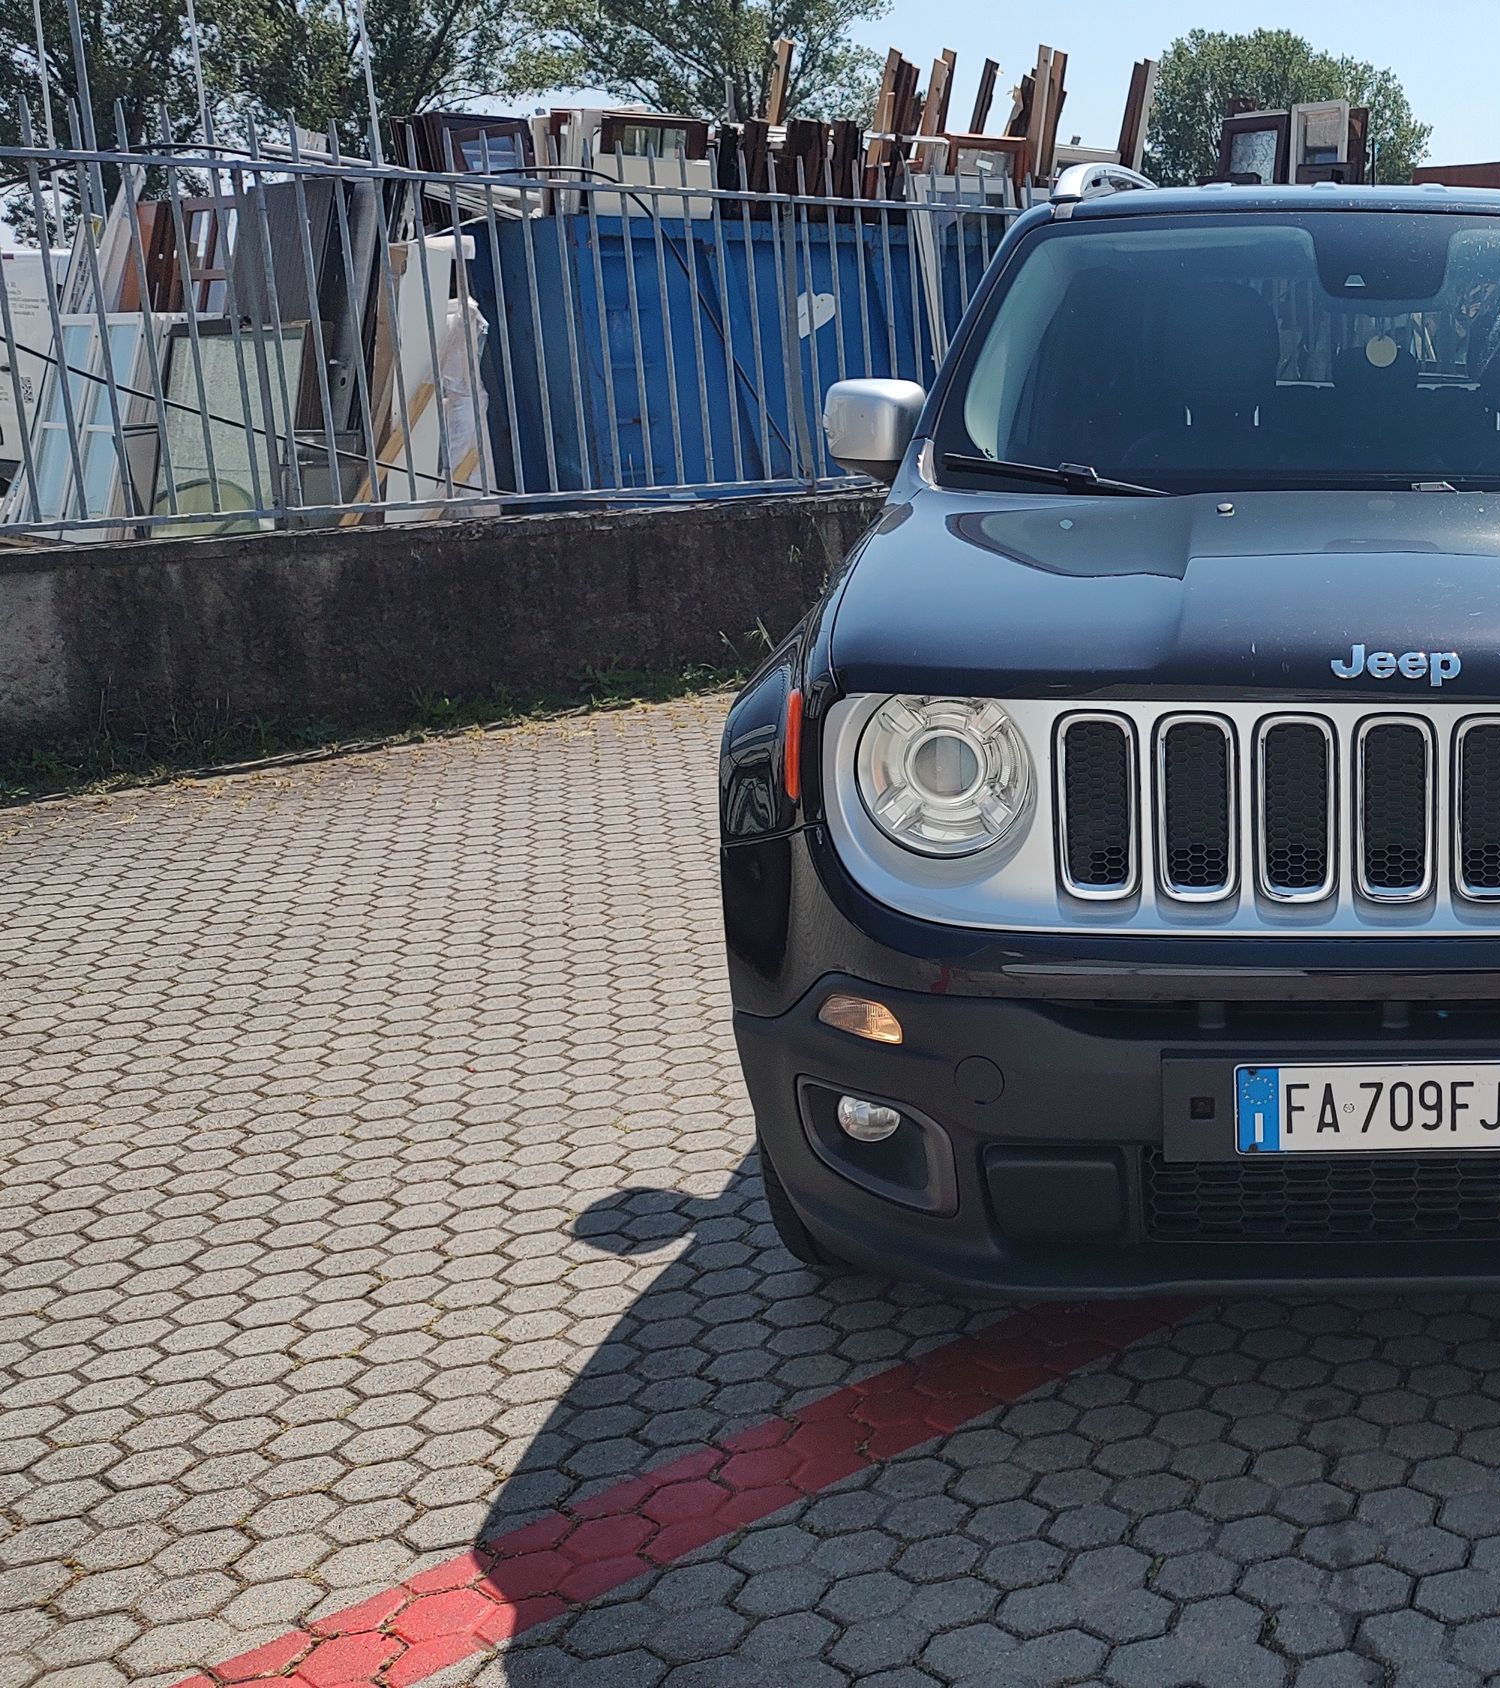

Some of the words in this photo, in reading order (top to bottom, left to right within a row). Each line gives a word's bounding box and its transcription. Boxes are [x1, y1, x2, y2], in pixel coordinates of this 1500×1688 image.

[1330, 643, 1462, 687] Jeep
[1253, 1112, 1264, 1143] I
[1285, 1082, 1341, 1135] FA
